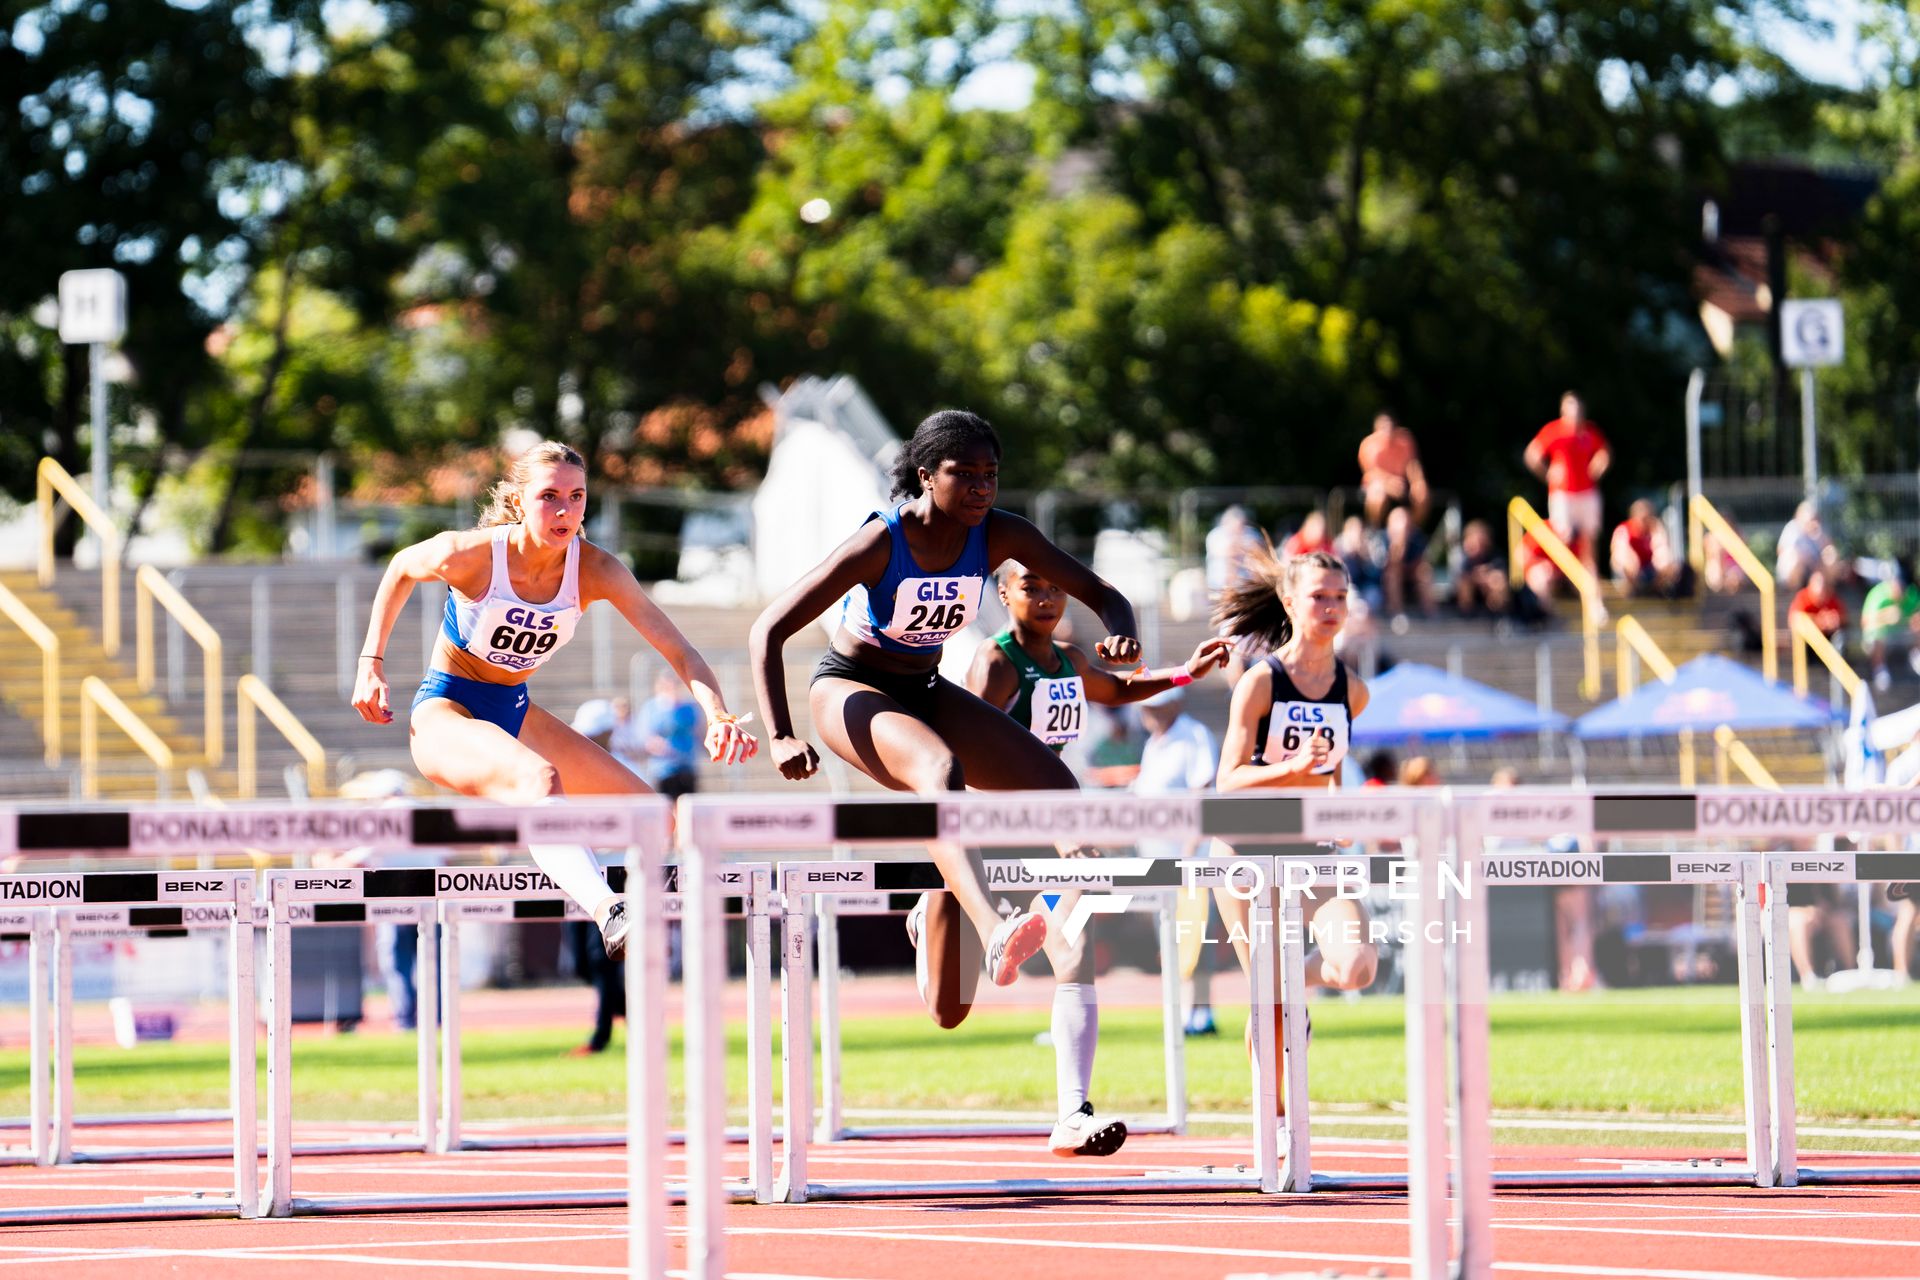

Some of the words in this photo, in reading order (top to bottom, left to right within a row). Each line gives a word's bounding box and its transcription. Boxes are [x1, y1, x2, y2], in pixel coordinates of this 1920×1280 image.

[905, 604, 966, 631] 246
[490, 625, 558, 655] 609
[920, 633, 948, 641] PLAN
[1046, 702, 1081, 732] 201
[134, 813, 403, 841] DONAUSTADION
[938, 805, 1195, 832] DONAUSTADION
[1481, 860, 1601, 878] AUSTADION
[1677, 863, 1732, 873] BENZ
[1790, 861, 1845, 872] BENZ
[294, 879, 352, 890] BENZ
[807, 871, 864, 882] BENZ
[0, 880, 81, 899] TADION
[165, 881, 224, 892] BENZ
